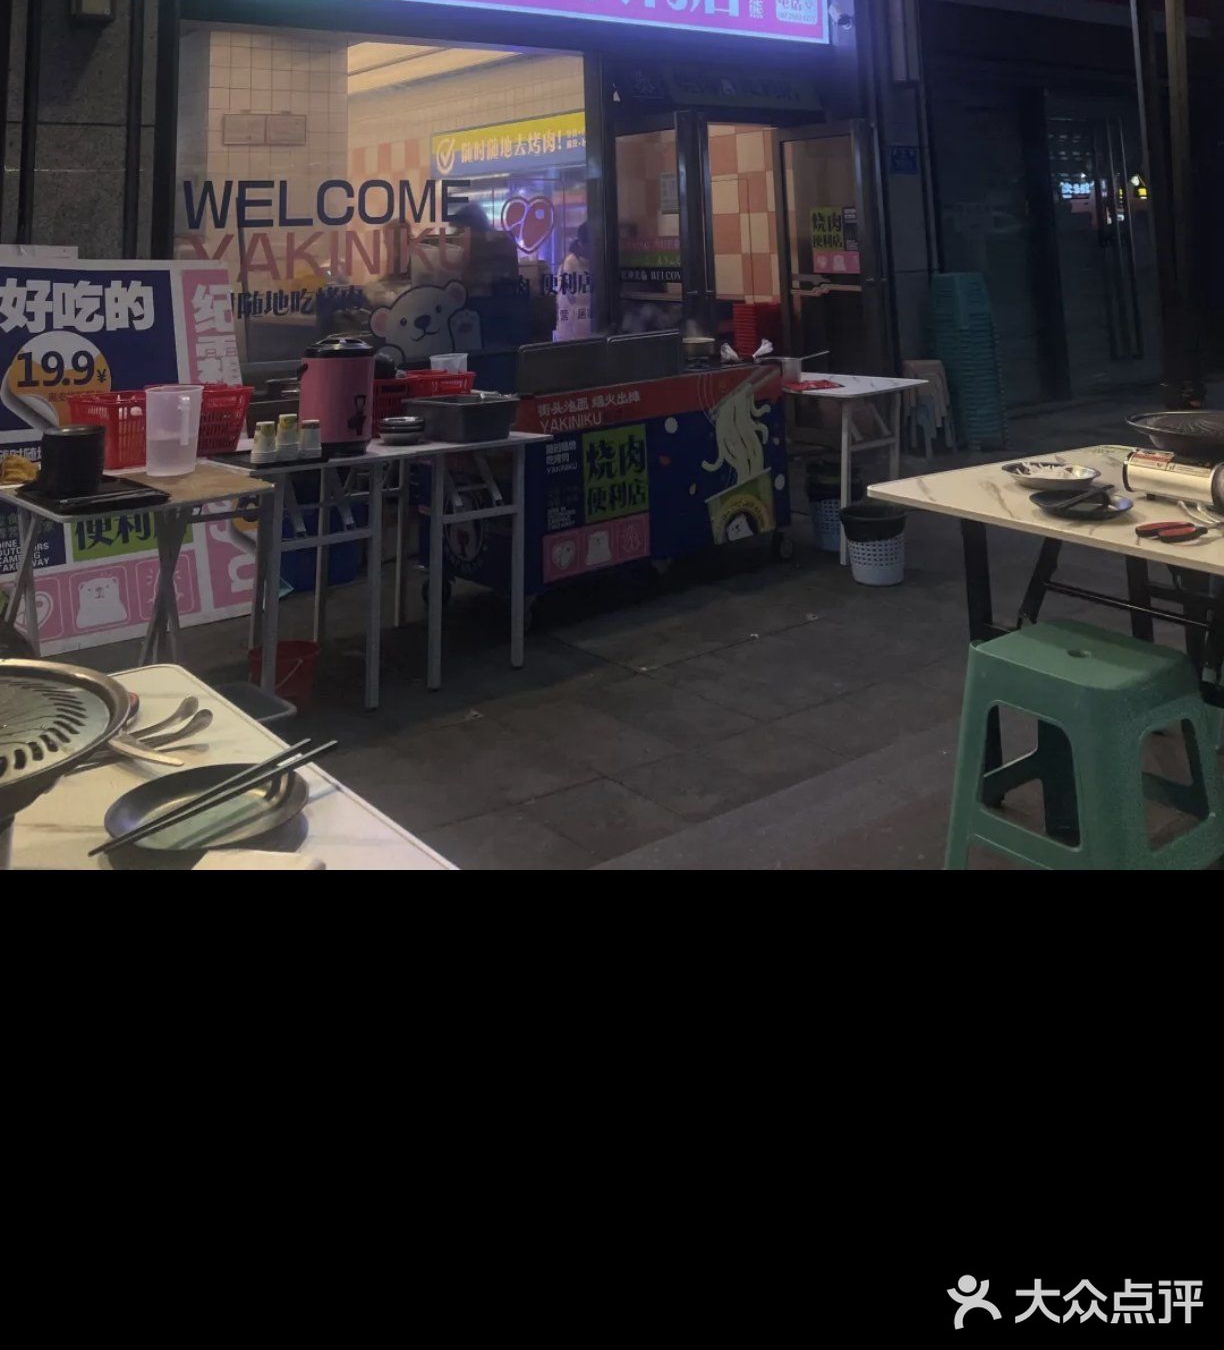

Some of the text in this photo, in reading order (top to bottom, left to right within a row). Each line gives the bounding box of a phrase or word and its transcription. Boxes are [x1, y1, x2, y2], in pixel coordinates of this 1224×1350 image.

[183, 179, 471, 229] WELCOME
[187, 228, 472, 283] YAKINIKU
[0, 278, 155, 333] 好吃的
[231, 286, 365, 319] 随地吃烤肉
[540, 411, 602, 434] YAKINIKU
[586, 434, 646, 481] 烧肉
[587, 477, 647, 516] 便利店
[75, 512, 160, 551] 便利
